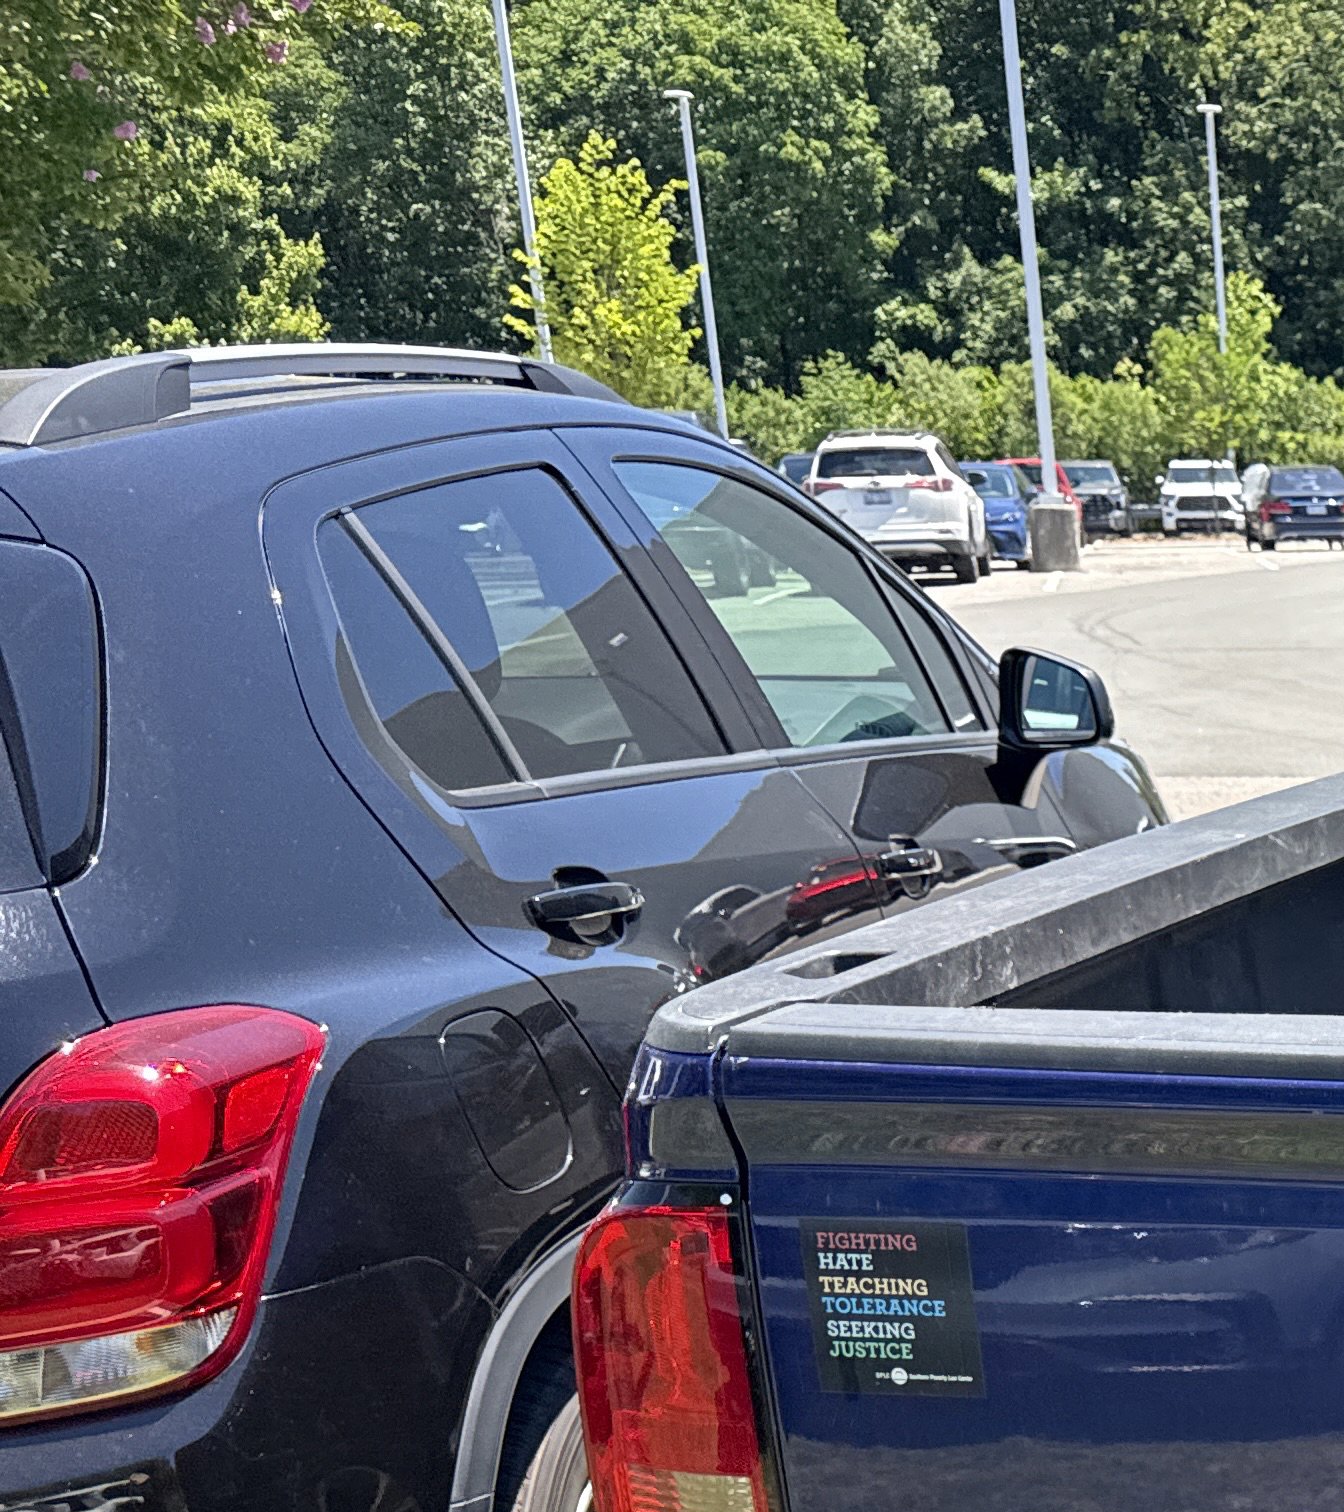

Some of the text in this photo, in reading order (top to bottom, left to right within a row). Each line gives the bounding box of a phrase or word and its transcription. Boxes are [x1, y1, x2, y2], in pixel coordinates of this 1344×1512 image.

[816, 1232, 917, 1251] FIGHTING
[818, 1253, 874, 1271] HATE
[818, 1276, 929, 1296] TEACHING
[821, 1297, 947, 1317] TOLERANCE
[827, 1320, 916, 1340] SEEKING
[829, 1341, 913, 1360] JUSTICE
